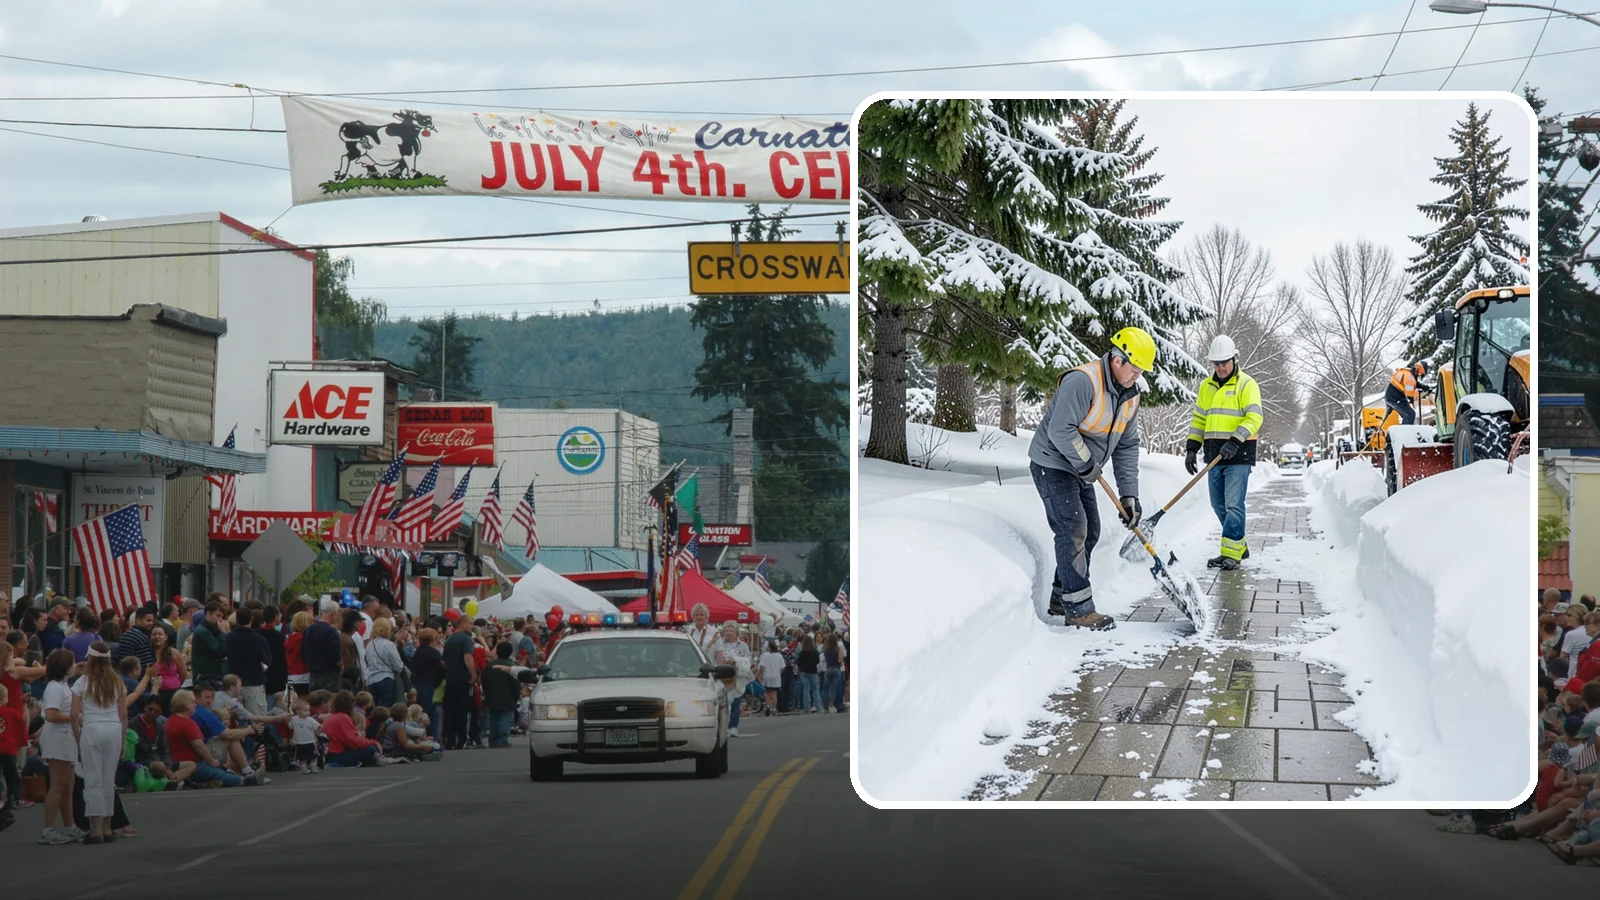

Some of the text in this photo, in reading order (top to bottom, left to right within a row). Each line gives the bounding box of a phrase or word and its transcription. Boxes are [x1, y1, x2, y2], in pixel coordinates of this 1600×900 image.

[482, 141, 604, 192] JULY
[632, 150, 747, 198] 4th.
[696, 254, 850, 280] CROSSWA
[283, 380, 373, 420] ACE
[405, 410, 453, 422] CEDAR
[283, 421, 371, 437] Hardware
[416, 428, 477, 446] Coca-Cola
[353, 467, 384, 480] Simpl
[83, 485, 155, 495] St. Vincent de Paul
[688, 526, 741, 535] CRNATION
[699, 535, 730, 544] GLASS
